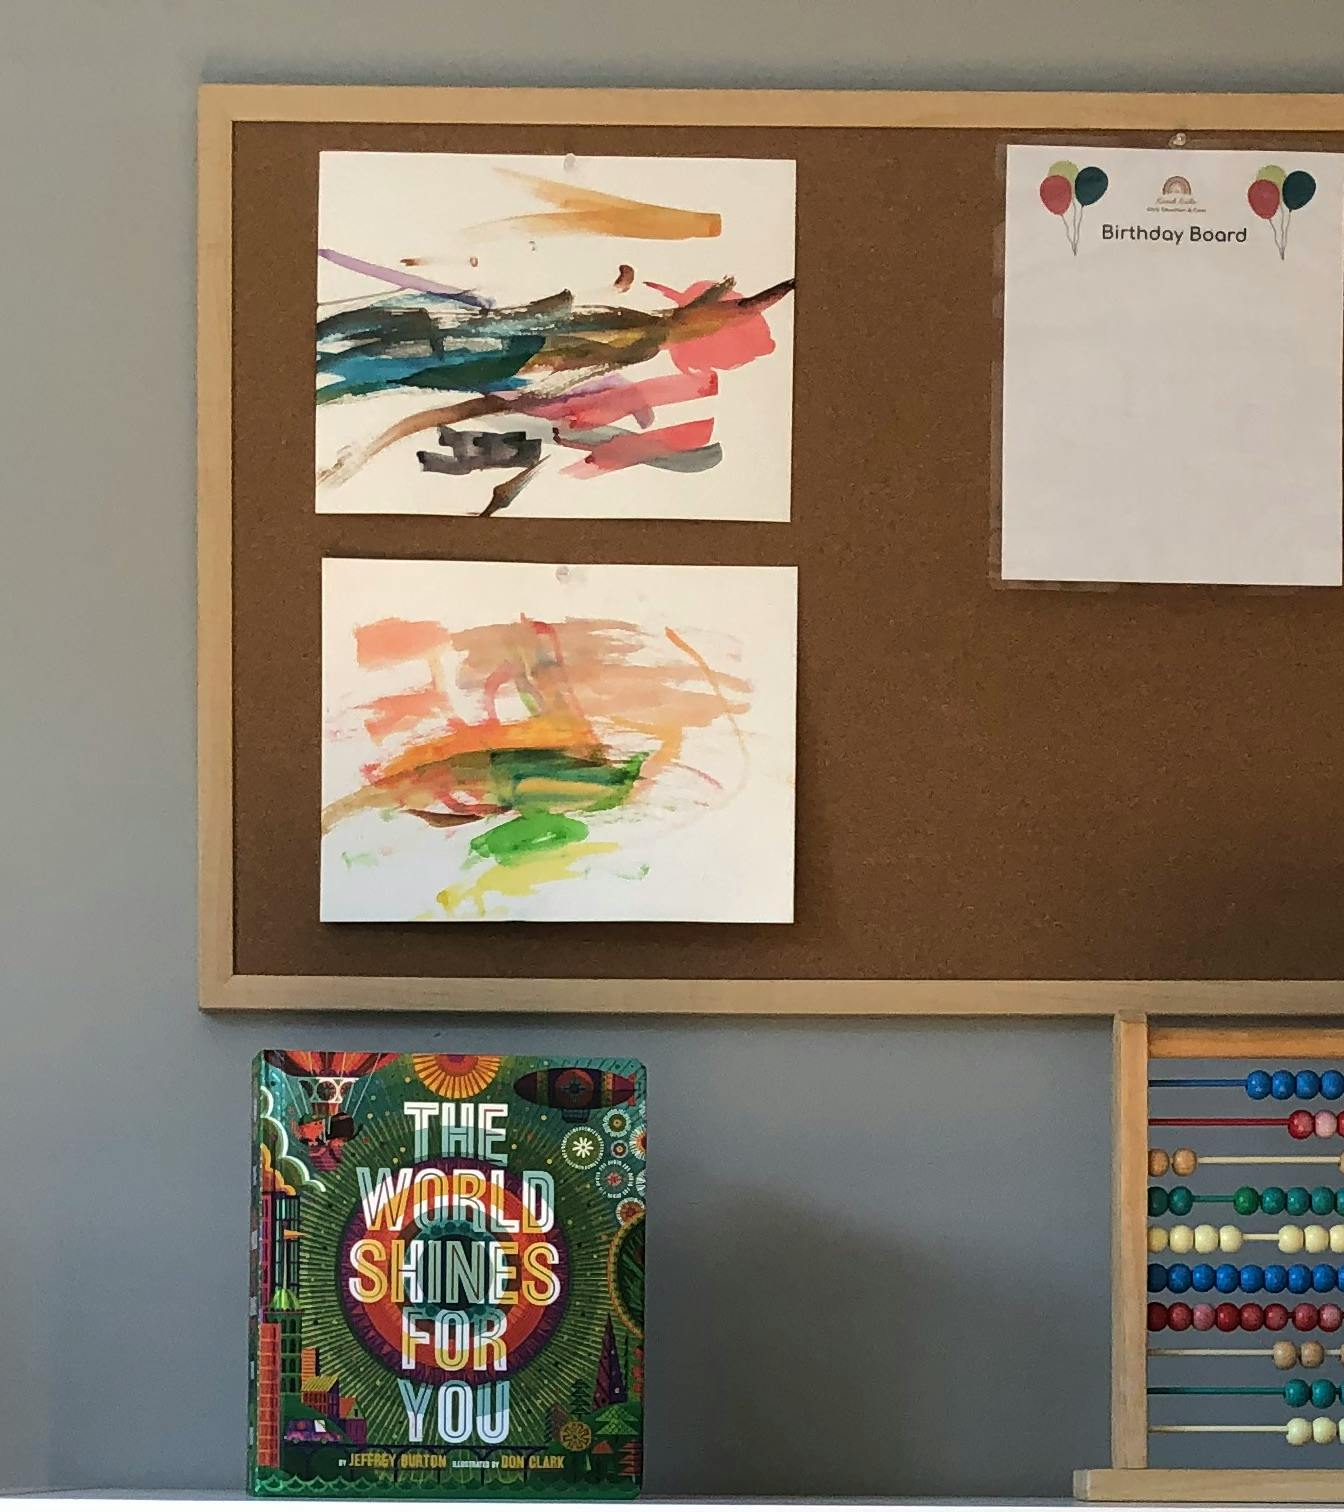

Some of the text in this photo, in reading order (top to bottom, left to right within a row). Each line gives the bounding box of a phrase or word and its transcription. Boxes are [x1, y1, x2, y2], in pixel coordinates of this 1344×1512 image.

[1102, 224, 1247, 245] Birthday Board
[404, 1102, 508, 1166] THE
[356, 1167, 555, 1234] WORLD
[348, 1239, 561, 1306] SHINES
[402, 1307, 507, 1371] FOR
[397, 1378, 510, 1444] YOU
[349, 1453, 396, 1468] JEFFREY
[401, 1454, 446, 1468] BURTON
[501, 1455, 524, 1469] DON
[529, 1455, 565, 1469] CLARK
